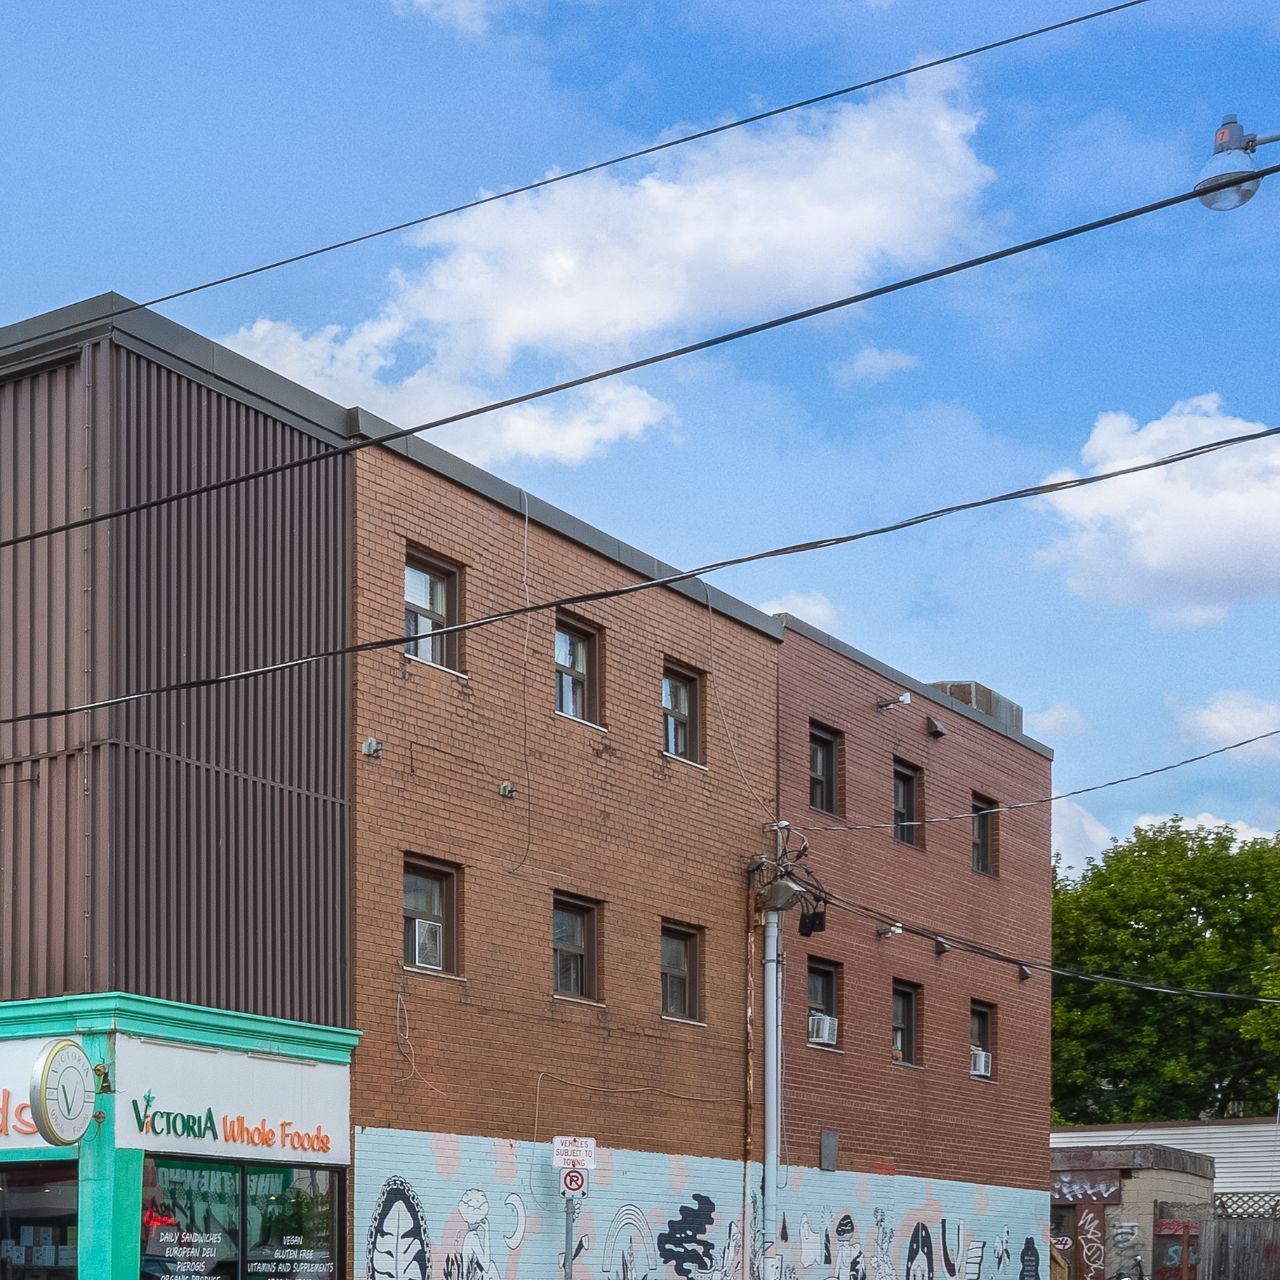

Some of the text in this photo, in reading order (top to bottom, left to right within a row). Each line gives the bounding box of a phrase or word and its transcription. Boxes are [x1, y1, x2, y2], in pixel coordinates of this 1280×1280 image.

[223, 1115, 275, 1147] Whole
[281, 1121, 331, 1153] Foods
[560, 1140, 589, 1149] VEHICLES
[555, 1148, 593, 1158] SUBJECT TO
[159, 1232, 222, 1243] DAILY SANDWICHES
[283, 1235, 303, 1245] VEGAN
[165, 1247, 217, 1257] EUROPEAN DELI
[274, 1248, 314, 1259] GLUTEN FREE
[176, 1261, 206, 1272] PIEROGIS
[247, 1262, 334, 1273] VITAMINS AND SUPPLEMENTS
